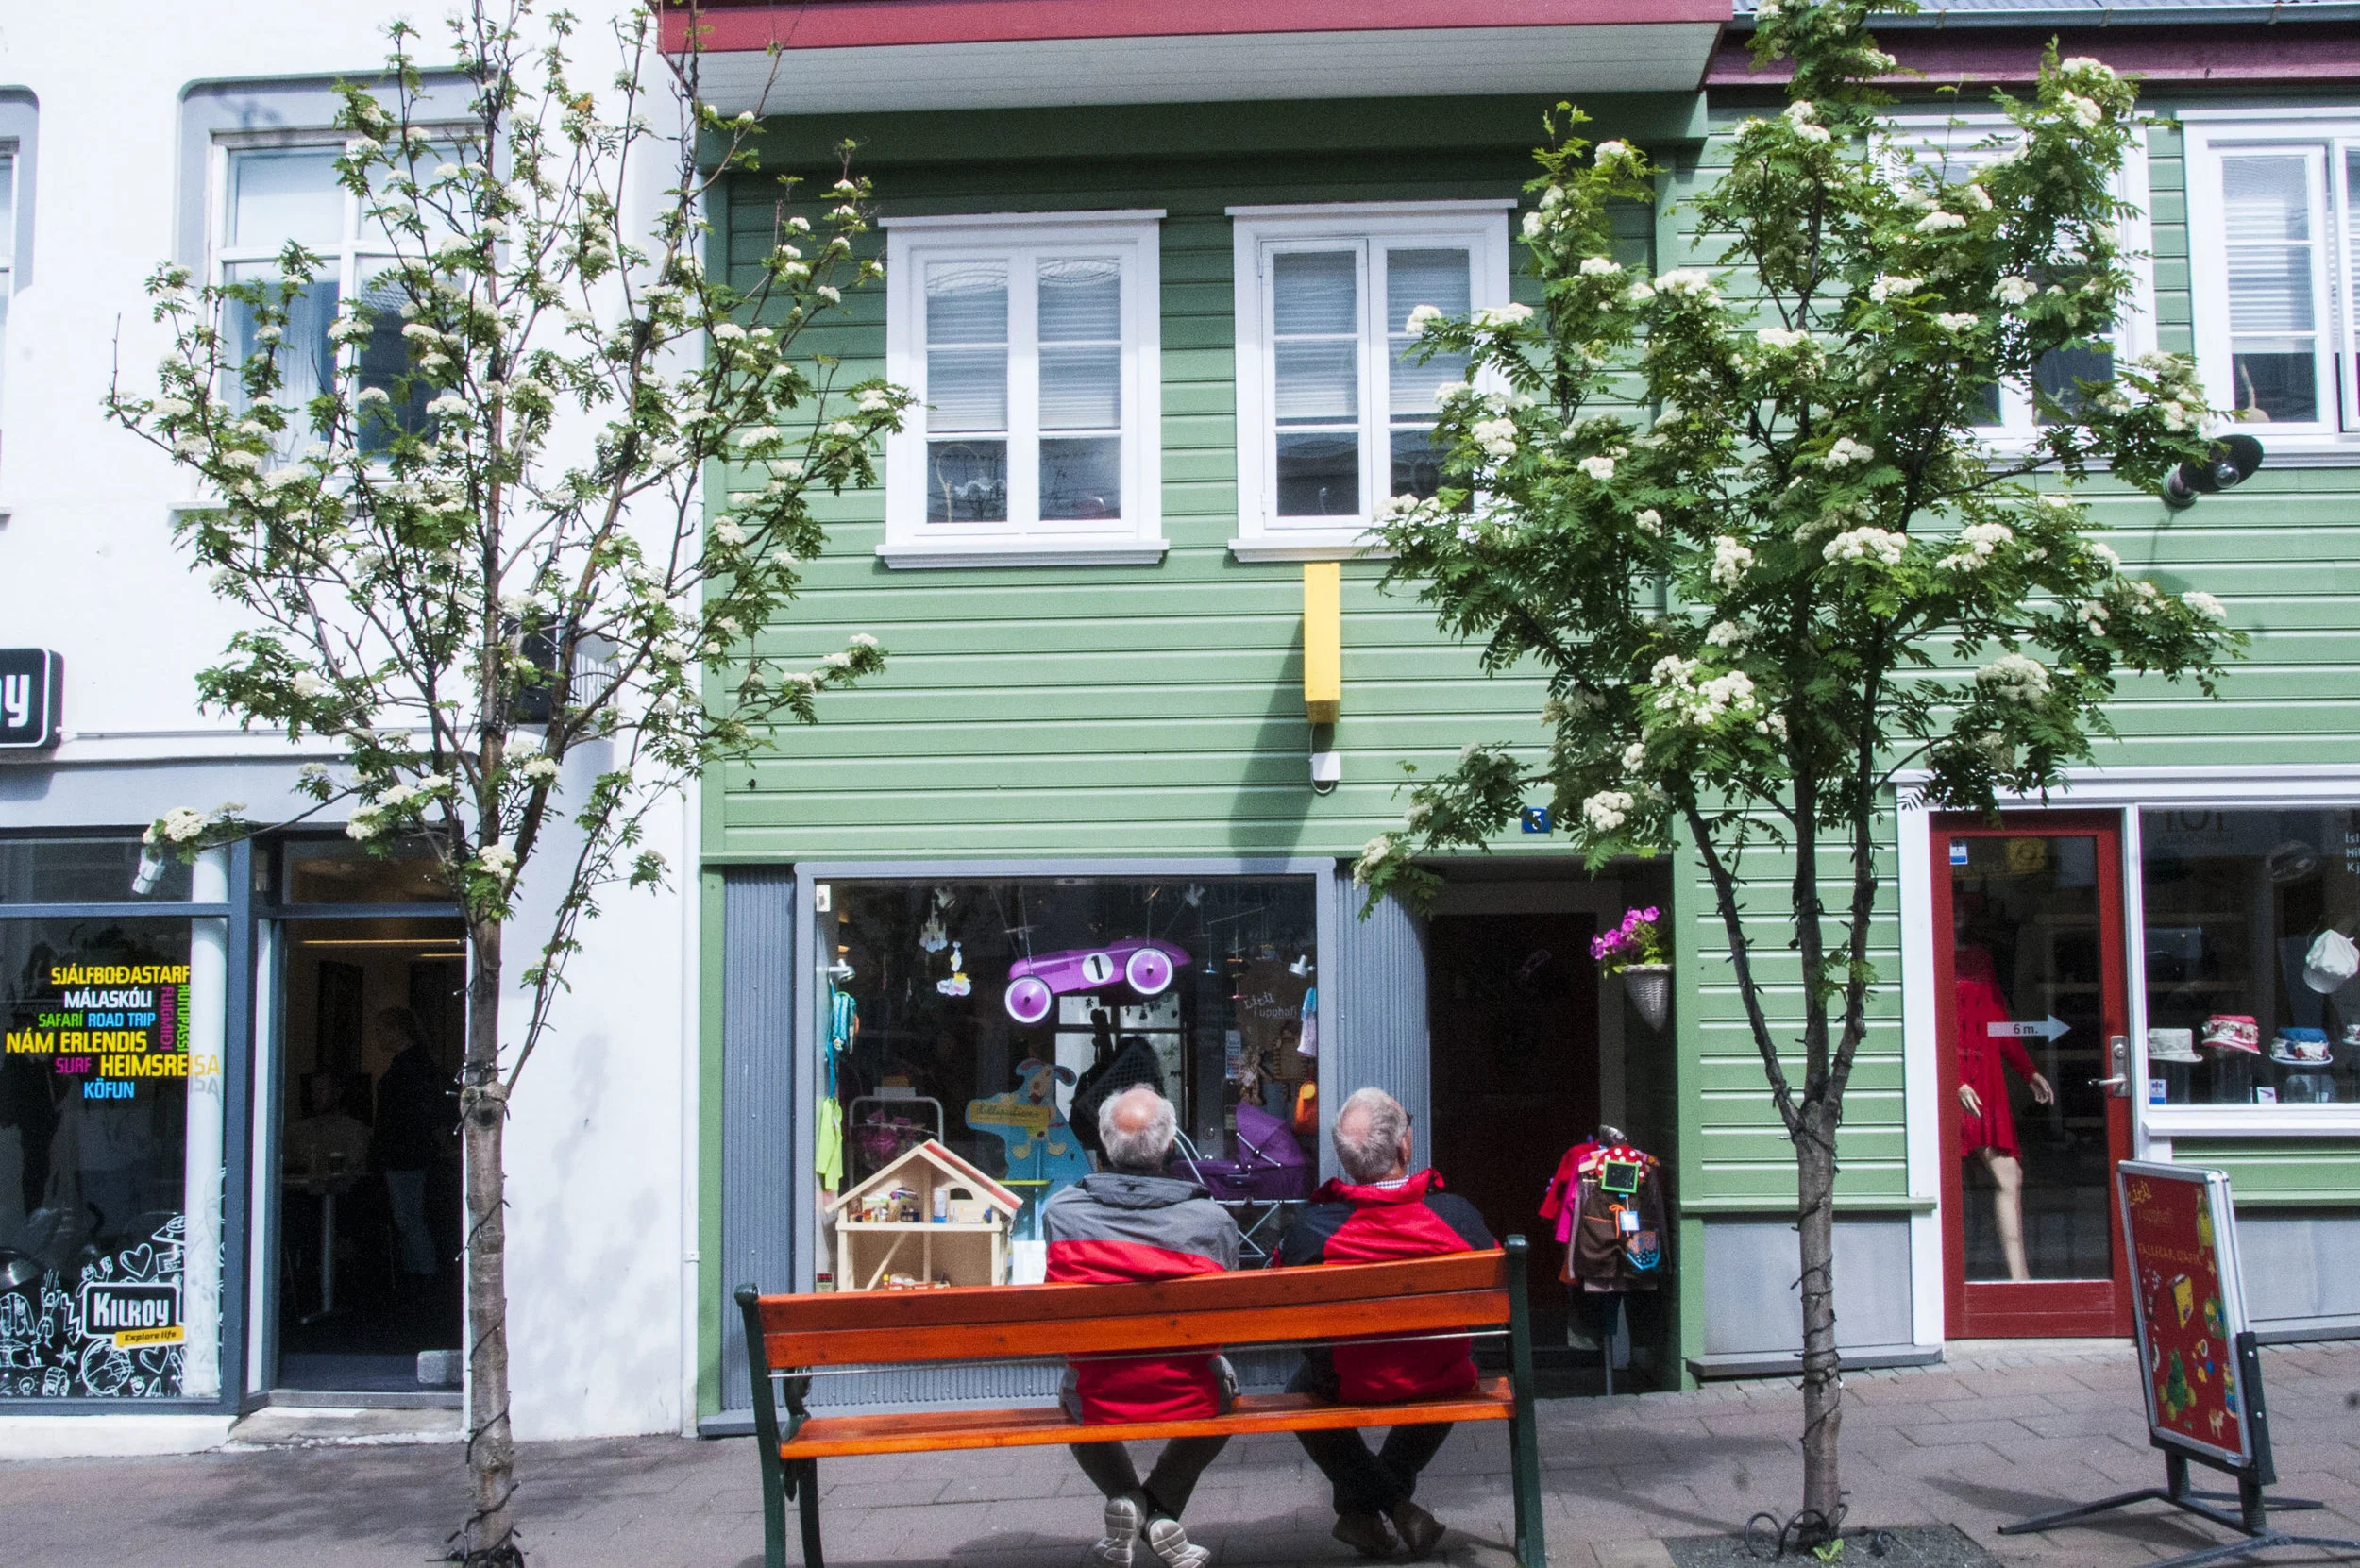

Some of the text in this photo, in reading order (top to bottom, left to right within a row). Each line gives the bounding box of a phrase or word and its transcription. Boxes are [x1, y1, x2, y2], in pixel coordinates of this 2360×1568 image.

[51, 963, 191, 985] SJÁLFBOÐASTARF
[1090, 954, 1104, 980] 1
[64, 987, 153, 1009] MÁLASKÓLI
[39, 1010, 156, 1028] SAFARÍ ROAD TRIP
[2014, 1023, 2038, 1035] 6 m.
[6, 1028, 147, 1054] NÁM ERLENDIS
[55, 1054, 220, 1076] SURF HEIMSREISA
[84, 1078, 134, 1099] KÖFUN
[124, 1330, 177, 1342] Explore life
